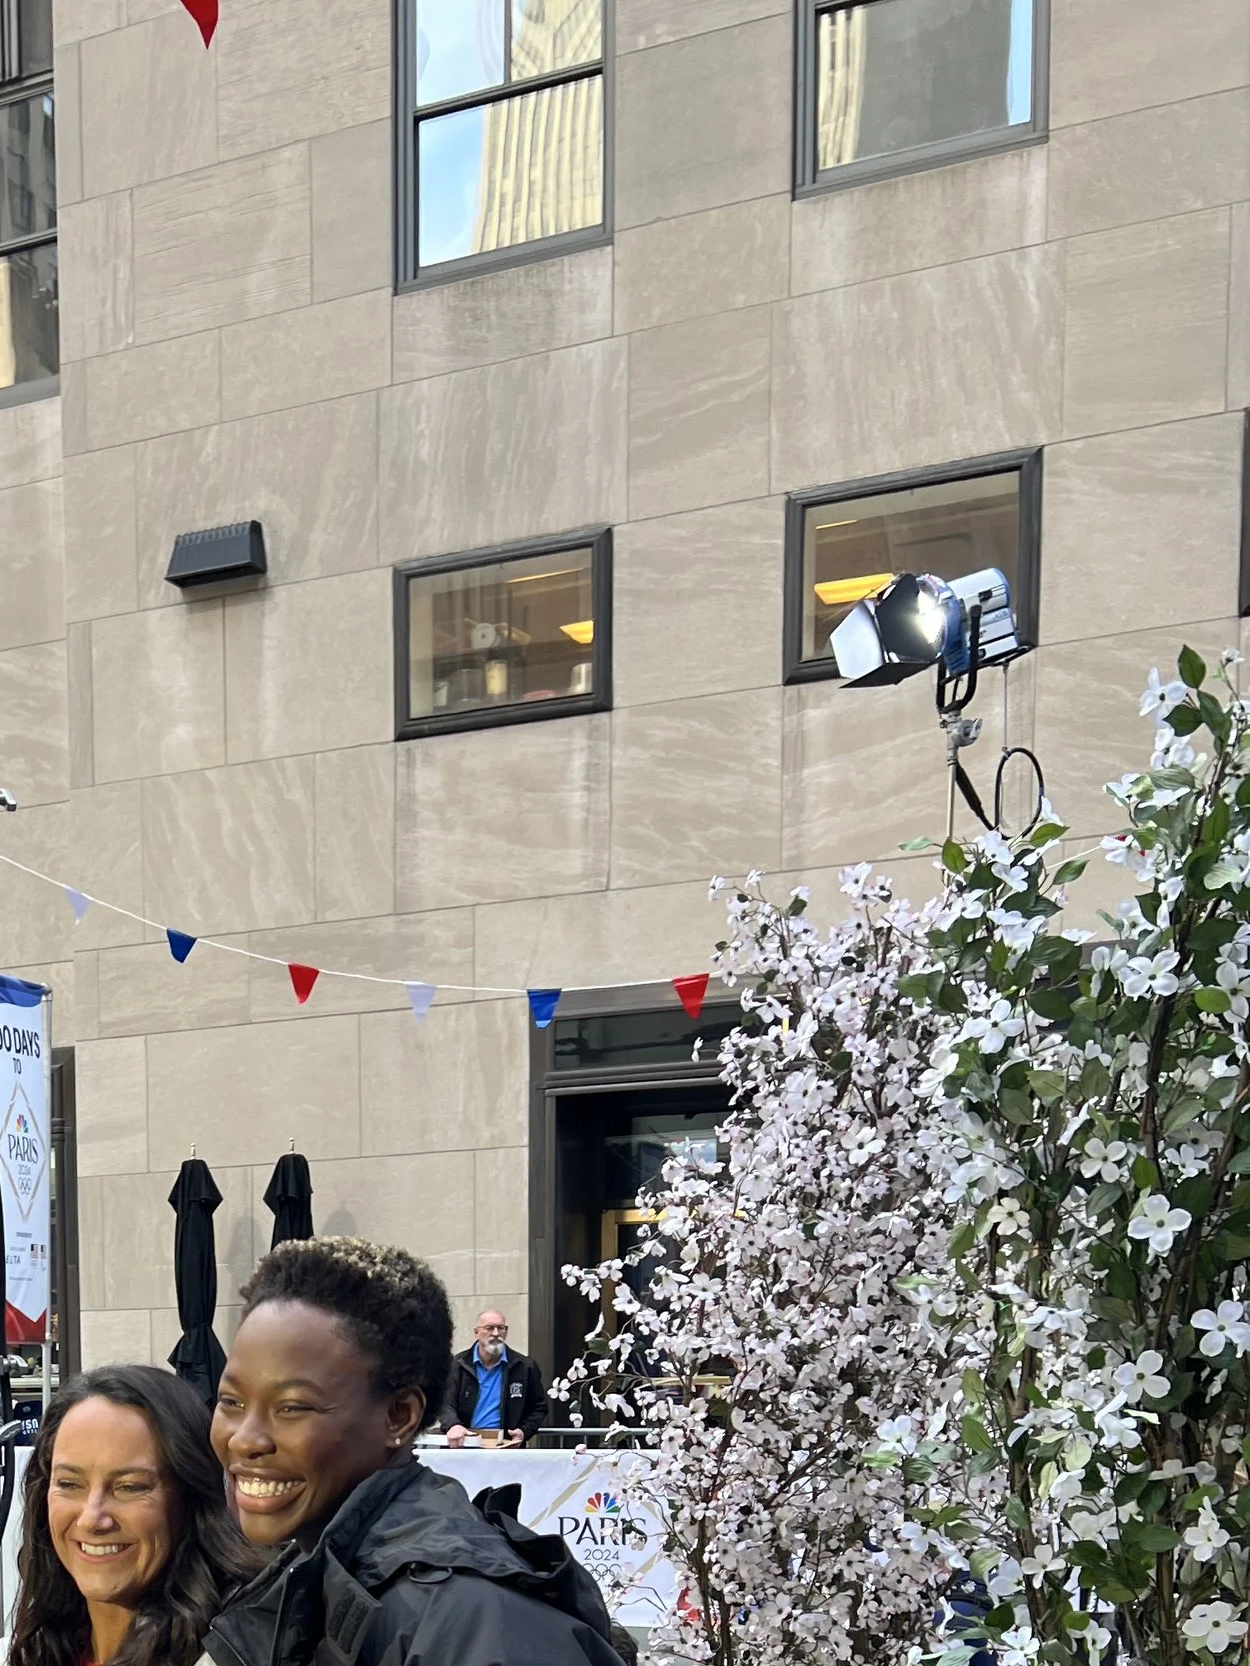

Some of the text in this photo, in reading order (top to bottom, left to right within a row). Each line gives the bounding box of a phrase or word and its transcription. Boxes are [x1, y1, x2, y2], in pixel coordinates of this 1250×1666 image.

[13, 1027, 41, 1059] DAYS
[12, 1057, 22, 1075] TO
[7, 1133, 39, 1165] PARIS
[584, 1548, 621, 1561] 2024
